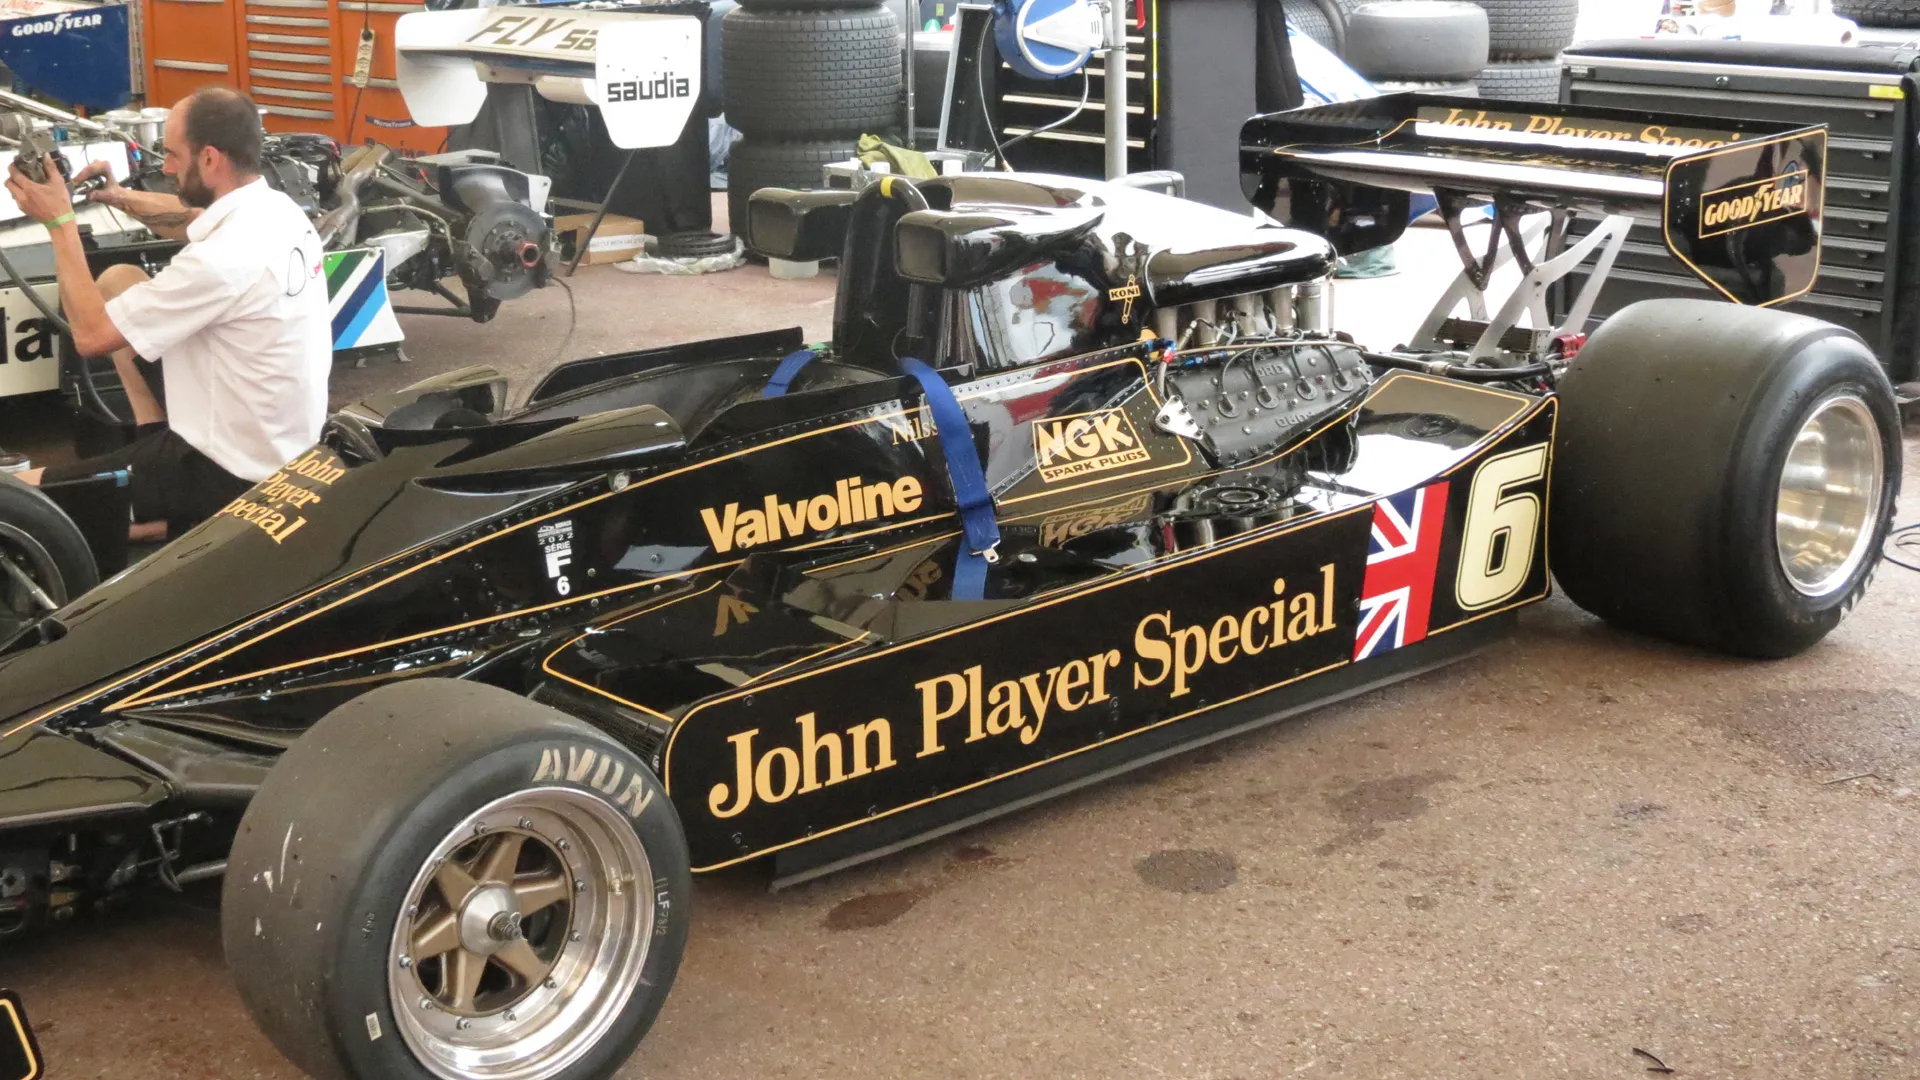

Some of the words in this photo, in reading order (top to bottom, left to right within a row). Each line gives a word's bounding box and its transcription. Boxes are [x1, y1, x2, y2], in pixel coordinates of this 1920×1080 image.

[12, 13, 102, 37] GOODYEAR
[466, 16, 576, 46] FLY
[607, 72, 690, 102] saudia
[1704, 183, 1803, 226] GOODYEAR
[1110, 287, 1139, 299] KONI
[892, 416, 938, 445] Nilss
[1038, 413, 1134, 466] NGK
[1044, 461, 1095, 480] SPARK
[1098, 450, 1146, 468] PLUGS
[700, 475, 923, 554] Valvoline
[1455, 442, 1549, 612] 6
[539, 532, 573, 545] 2022
[545, 548, 572, 578] F
[556, 575, 571, 596] 6
[708, 714, 897, 819] John
[915, 649, 1121, 758] Player
[1134, 563, 1337, 699] Special
